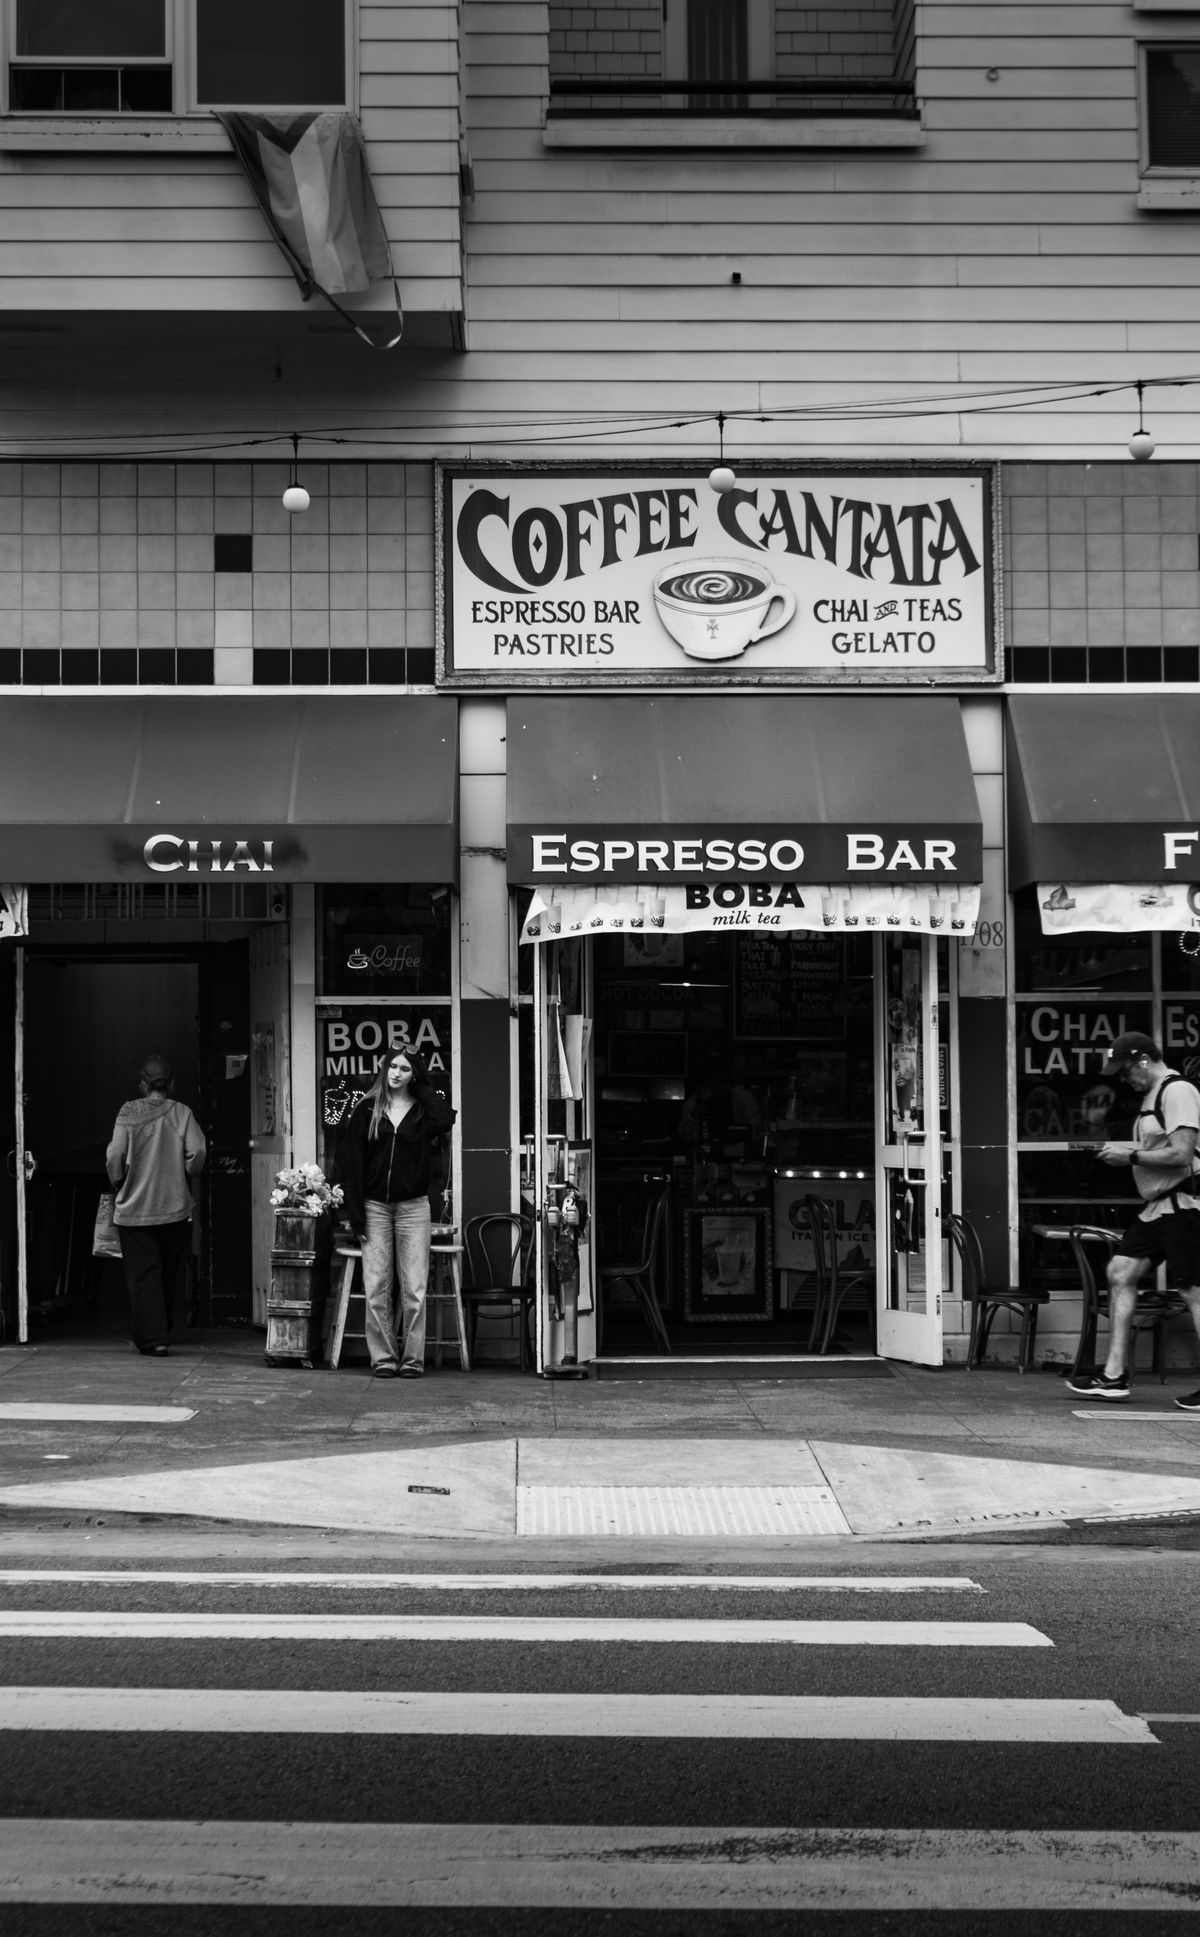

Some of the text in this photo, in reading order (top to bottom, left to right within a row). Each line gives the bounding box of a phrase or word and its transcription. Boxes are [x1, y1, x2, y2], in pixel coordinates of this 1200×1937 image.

[456, 487, 982, 594] COFFEE CANTATA
[471, 600, 642, 625] ESPRESSO BAR
[813, 598, 962, 624] CHAI AND TEAS
[493, 633, 615, 656] PASTRIES
[831, 632, 936, 654] GELATO
[143, 834, 274, 872] CHAI
[531, 834, 957, 872] ESPRESSO BAR
[1163, 831, 1199, 869] F
[686, 882, 805, 910] BOBA
[713, 910, 781, 925] milk tea
[369, 945, 421, 971] Coffee
[328, 1018, 441, 1052] BOBA
[1030, 1007, 1126, 1042] CHAI
[326, 1055, 387, 1076] MILK
[1024, 1047, 1110, 1076] LATT
[792, 1231, 843, 1241] ITAAN
[849, 1231, 869, 1242] ICE
